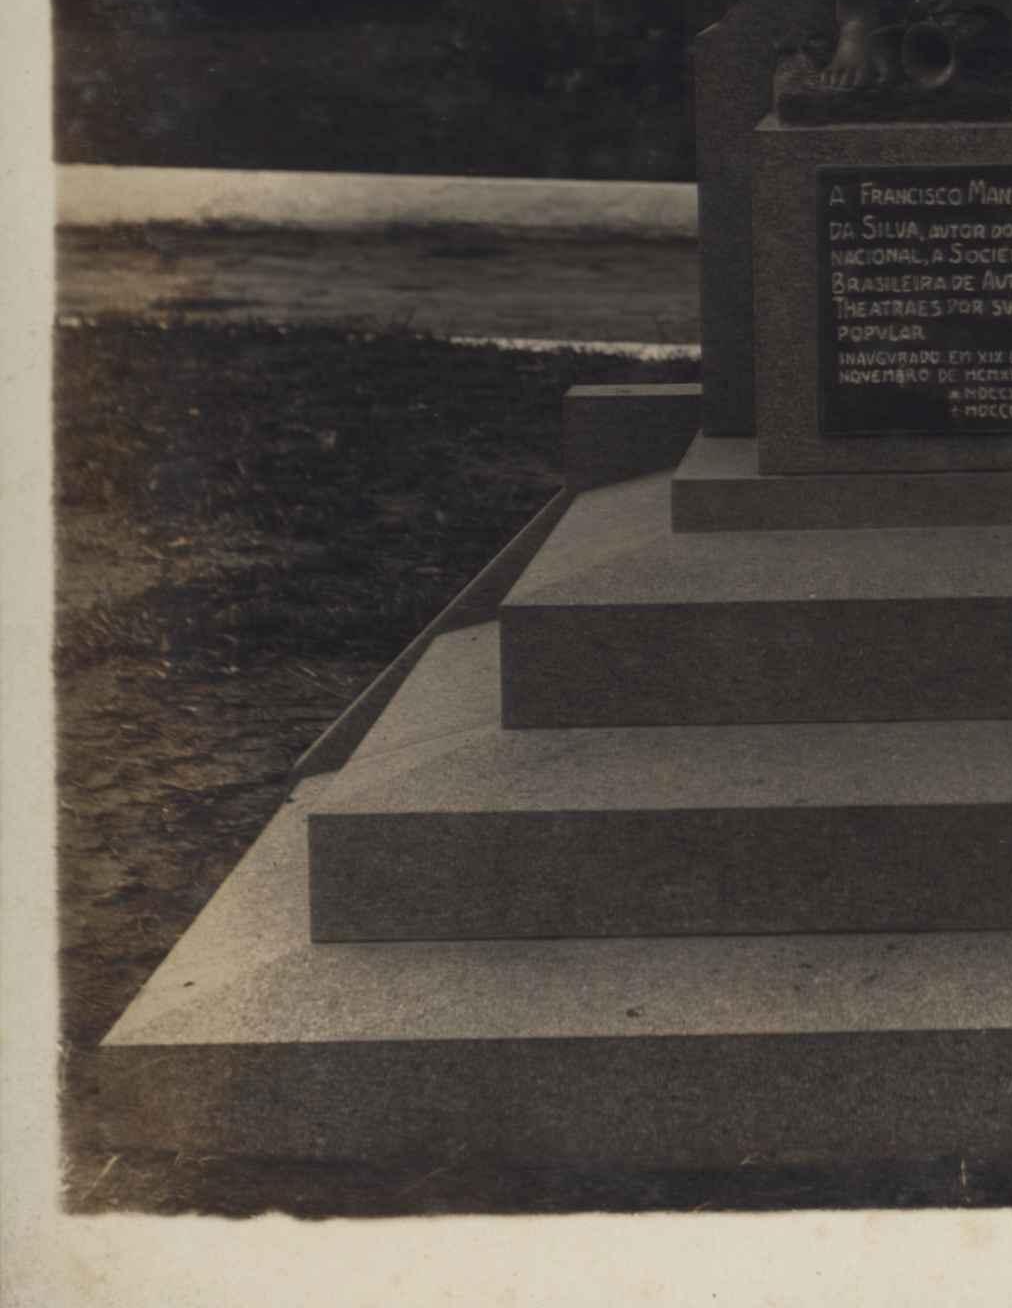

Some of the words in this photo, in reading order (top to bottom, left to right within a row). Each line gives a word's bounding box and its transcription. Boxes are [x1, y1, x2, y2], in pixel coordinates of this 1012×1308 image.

[829, 185, 846, 206] A
[860, 182, 963, 206] FRANCISCO
[829, 221, 855, 242] DA
[931, 248, 944, 264] A
[831, 271, 947, 294] BRASILEIRA
[951, 275, 976, 292] DE
[832, 295, 943, 319] THEATRAES
[946, 298, 984, 316] POR
[948, 349, 971, 365] EM
[838, 367, 931, 384] NOVEMBRO
[938, 367, 960, 383] DE
